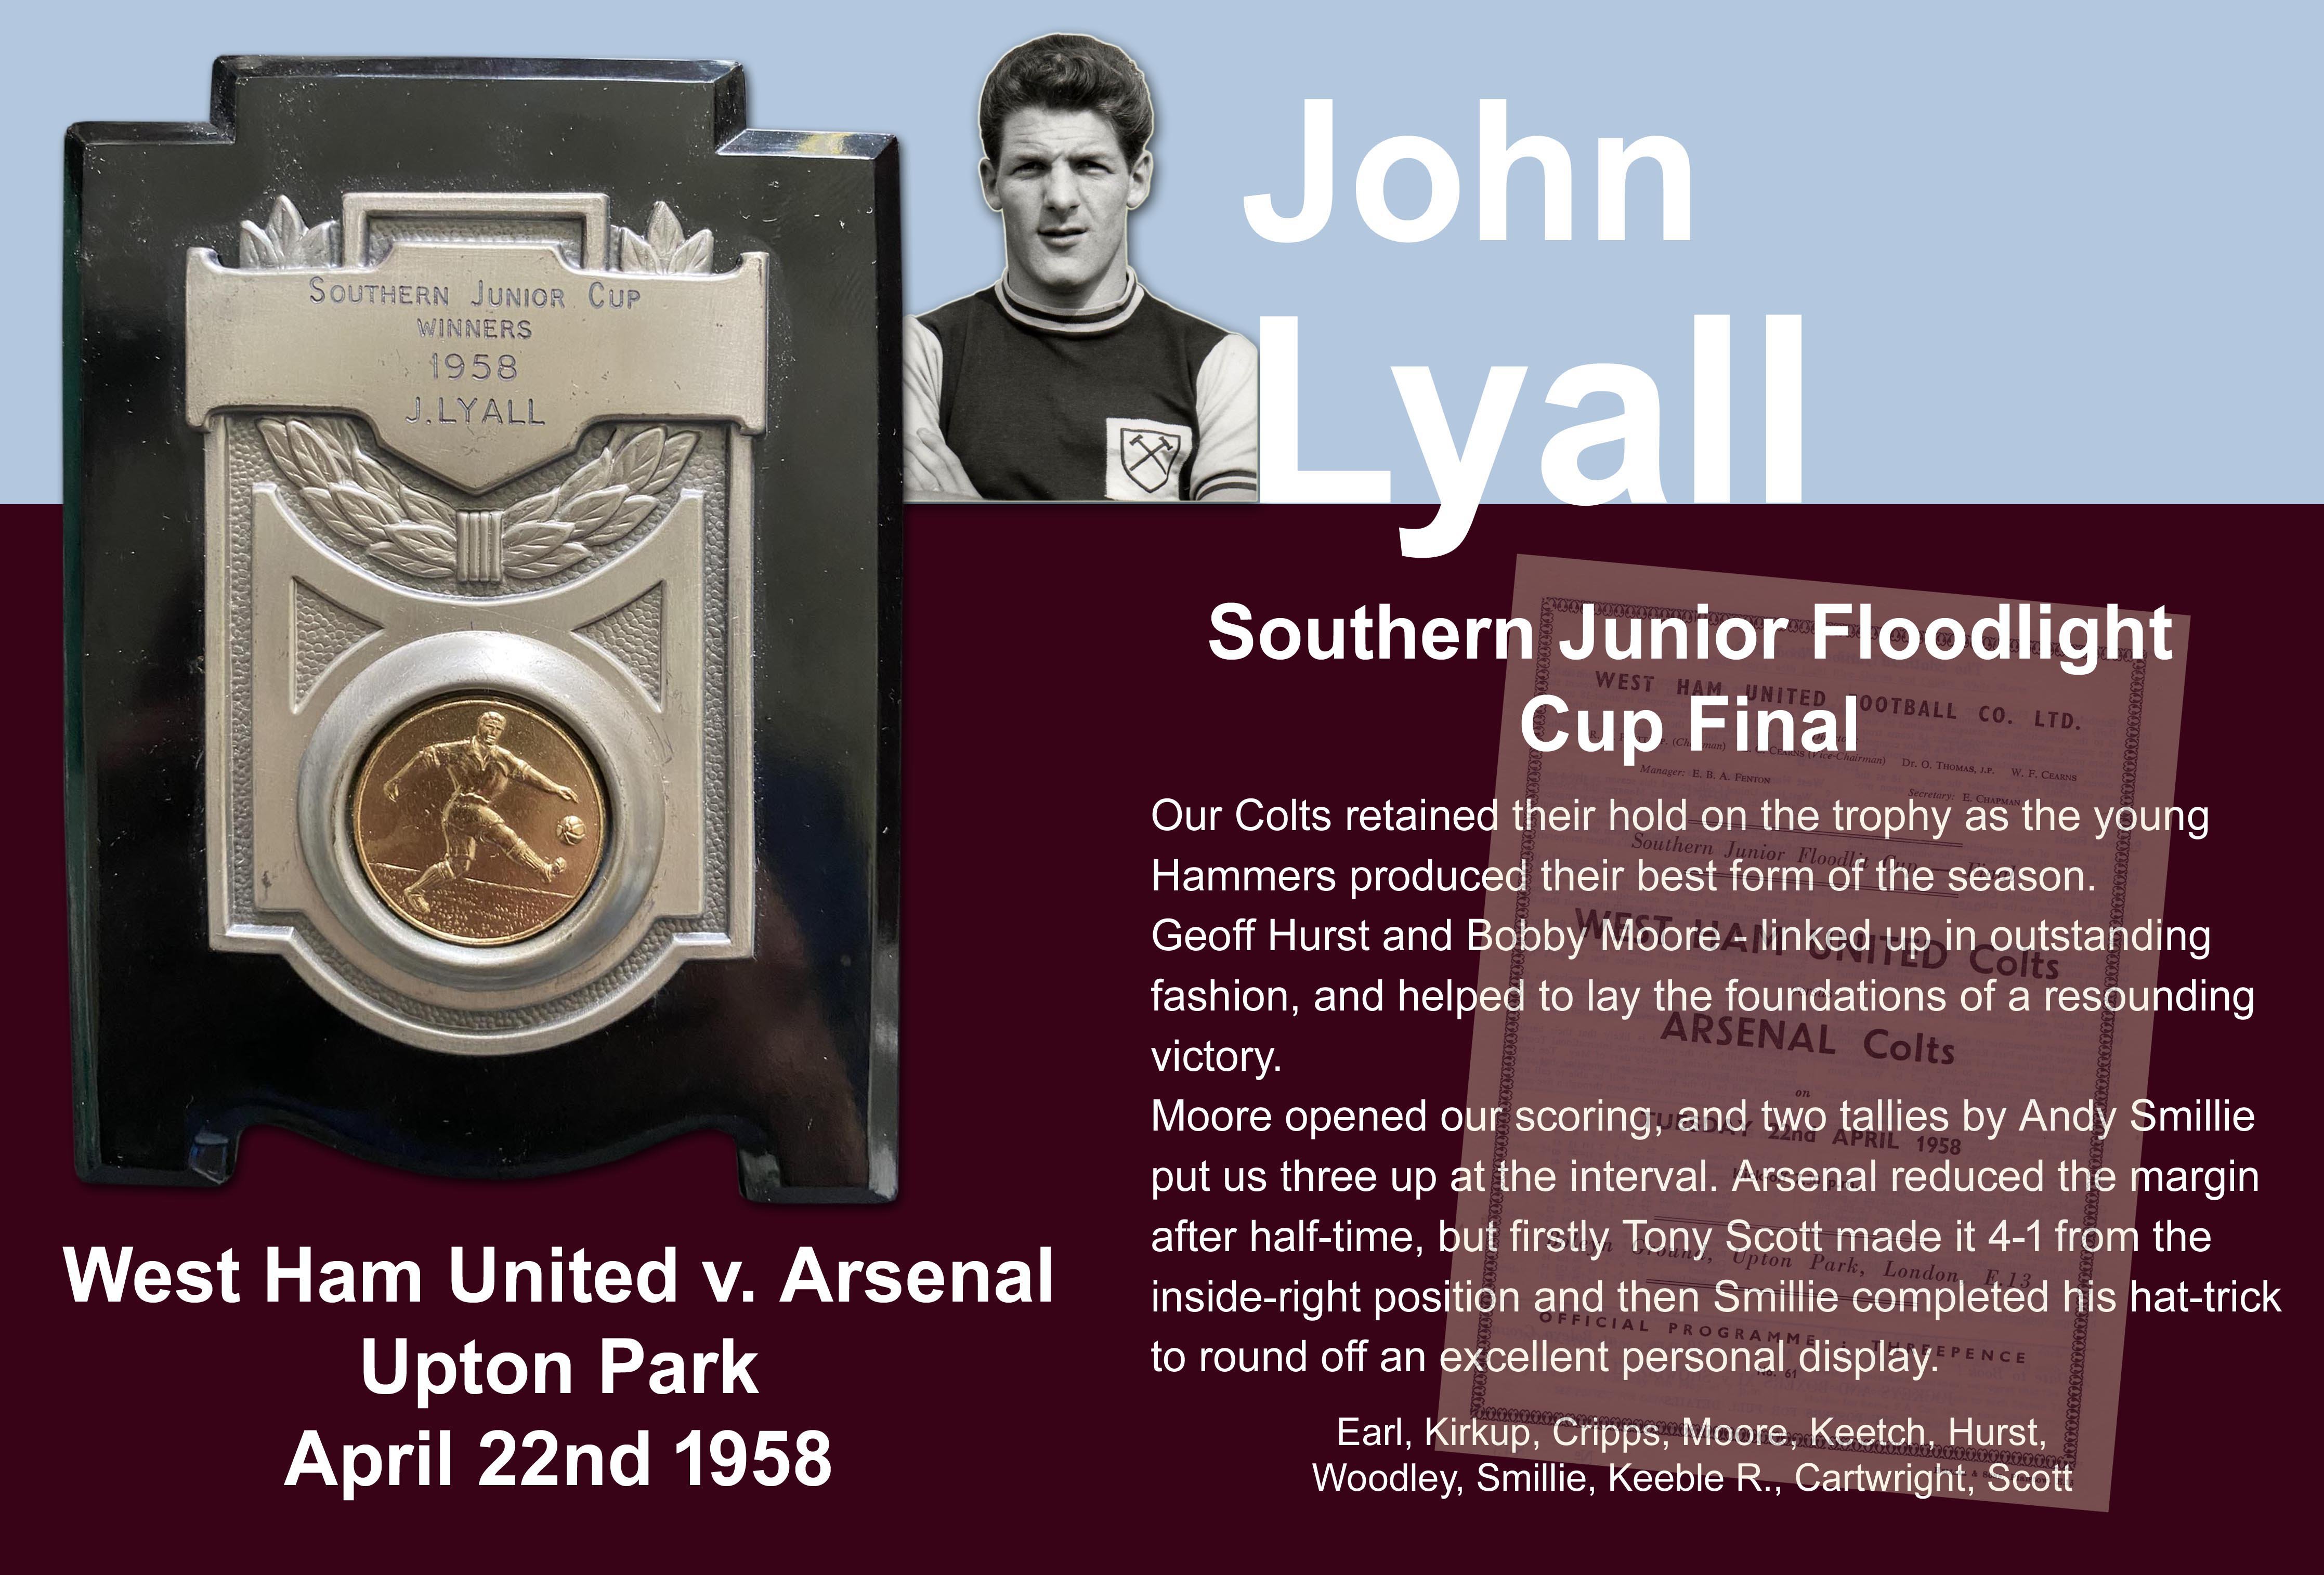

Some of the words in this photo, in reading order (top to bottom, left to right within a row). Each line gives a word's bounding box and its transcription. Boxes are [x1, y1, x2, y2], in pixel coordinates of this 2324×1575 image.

[417, 319, 532, 339] WINNERS
[432, 353, 518, 382] 1958
[406, 397, 545, 426] J.LYALL
[1595, 671, 1655, 692] WEST
[1677, 678, 1722, 697] HAM
[1745, 684, 1826, 707] UNITED
[1848, 693, 1957, 720] OOTBALL
[1979, 704, 2013, 725] CO.
[2034, 710, 2082, 731] LTD.
[1639, 764, 1686, 778] Manager:
[1692, 769, 1702, 778] E.
[1706, 769, 1716, 780] B.
[1719, 770, 1731, 781] A.
[1631, 832, 1715, 855] Southern
[1724, 839, 1787, 862] Junior
[1969, 943, 2060, 980] Colts
[1660, 1010, 1836, 1055] ARSENAL
[1863, 1028, 1955, 1066] Colts
[1795, 1088, 1811, 1098] on
[1832, 1127, 1900, 1149] APRIL
[1916, 1135, 1962, 1156] 1958
[1731, 1249, 1793, 1270] Upton
[1808, 1252, 1866, 1278] Park,
[1538, 1311, 1650, 1334] OFFICIAL
[1668, 1322, 1817, 1348] PROGRAMME
[1870, 1338, 2027, 1365] THREEPENCE
